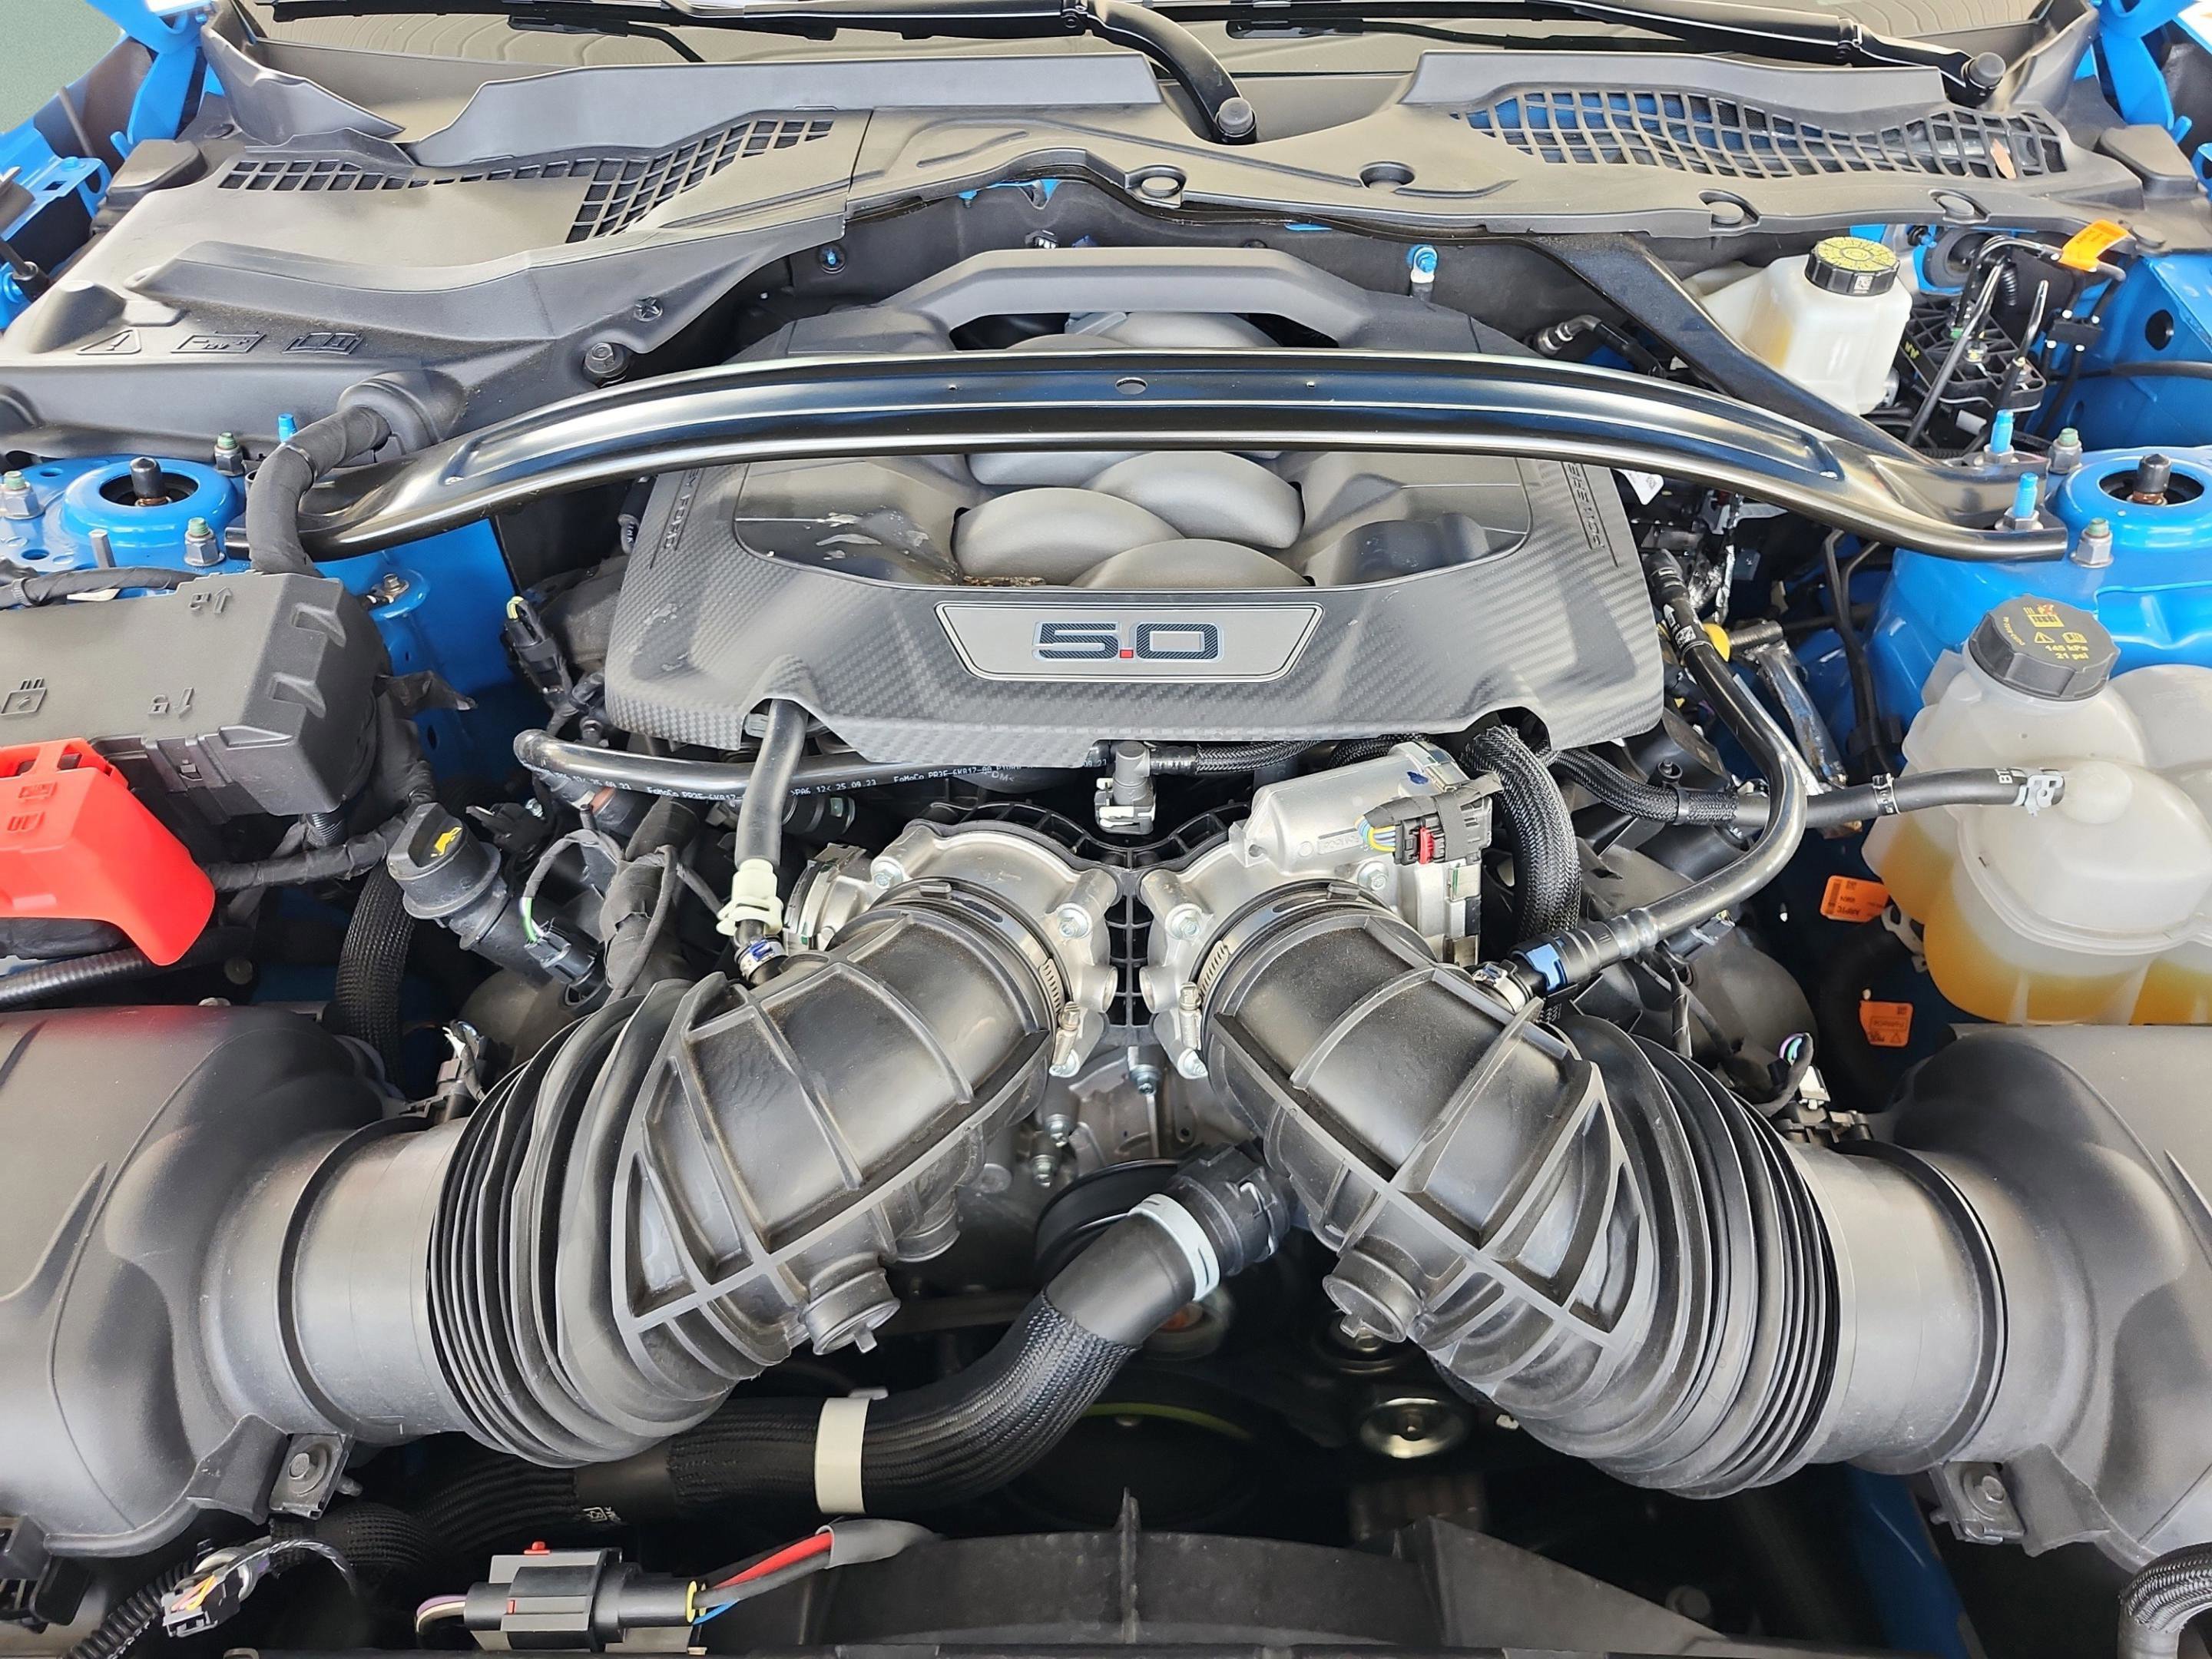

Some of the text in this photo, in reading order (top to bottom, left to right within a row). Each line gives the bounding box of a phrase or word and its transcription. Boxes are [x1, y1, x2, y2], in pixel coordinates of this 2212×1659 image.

[664, 493, 690, 548] FORD
[1568, 464, 1605, 548] POWERE
[1033, 622, 1224, 662] 5.0
[893, 773, 925, 783] FoMoCo
